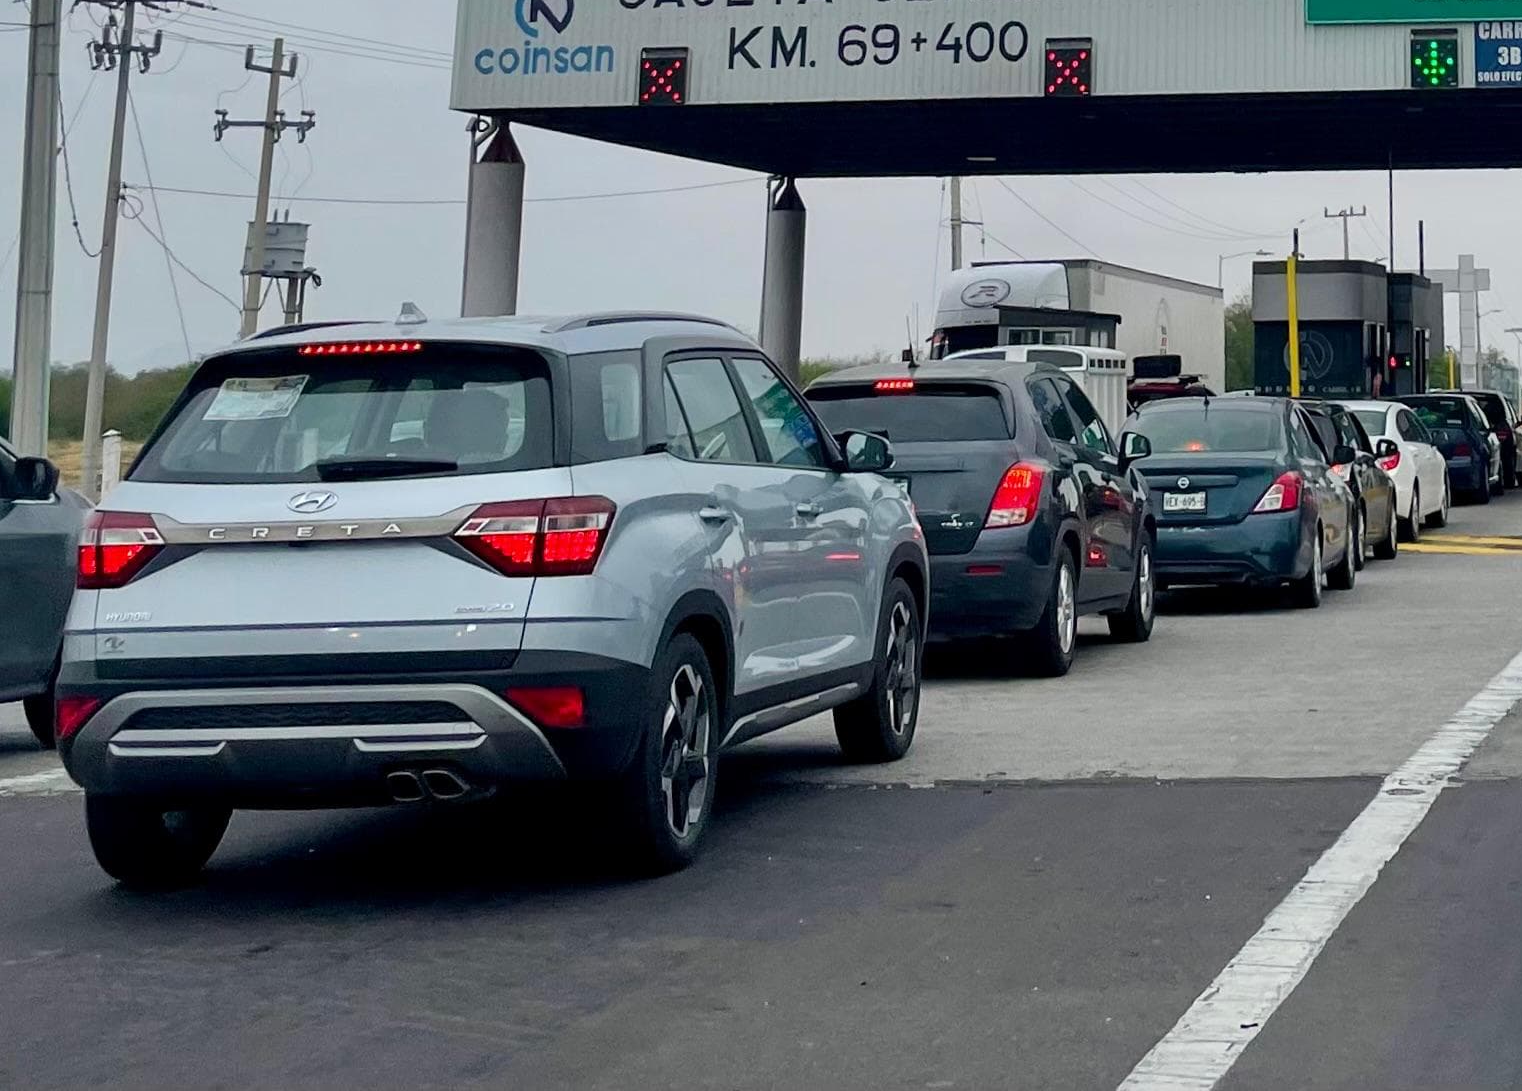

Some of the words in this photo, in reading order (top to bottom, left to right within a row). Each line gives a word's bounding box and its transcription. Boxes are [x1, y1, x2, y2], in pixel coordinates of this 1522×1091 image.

[727, 26, 816, 70] KM.
[838, 21, 1029, 66] 69+400
[474, 40, 614, 75] coinsan
[1498, 46, 1521, 65] 3B
[1477, 71, 1500, 82] SOLO
[208, 523, 401, 539] CRETA
